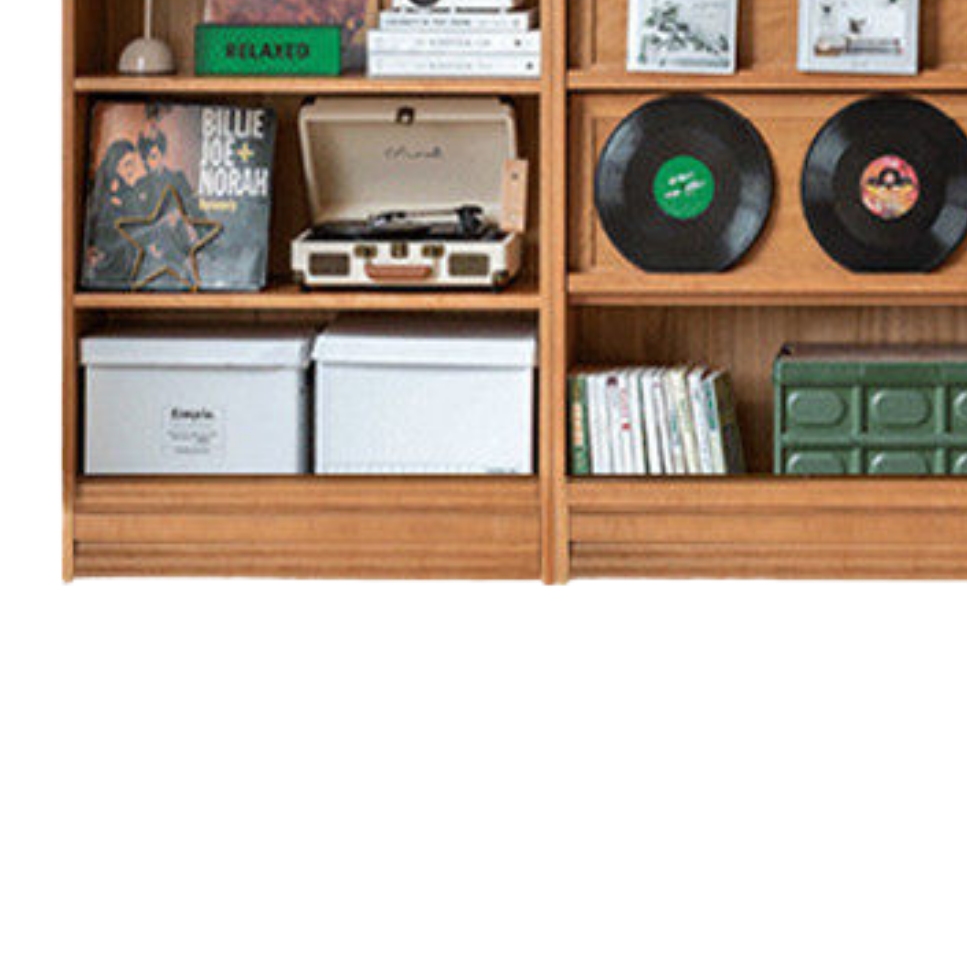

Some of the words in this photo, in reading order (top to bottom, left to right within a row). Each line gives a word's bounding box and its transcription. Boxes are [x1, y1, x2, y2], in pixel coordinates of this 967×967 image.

[225, 42, 311, 61] RELAXED
[201, 107, 265, 139] BILLIE
[200, 137, 235, 166] JOE
[198, 167, 269, 197] NORAH
